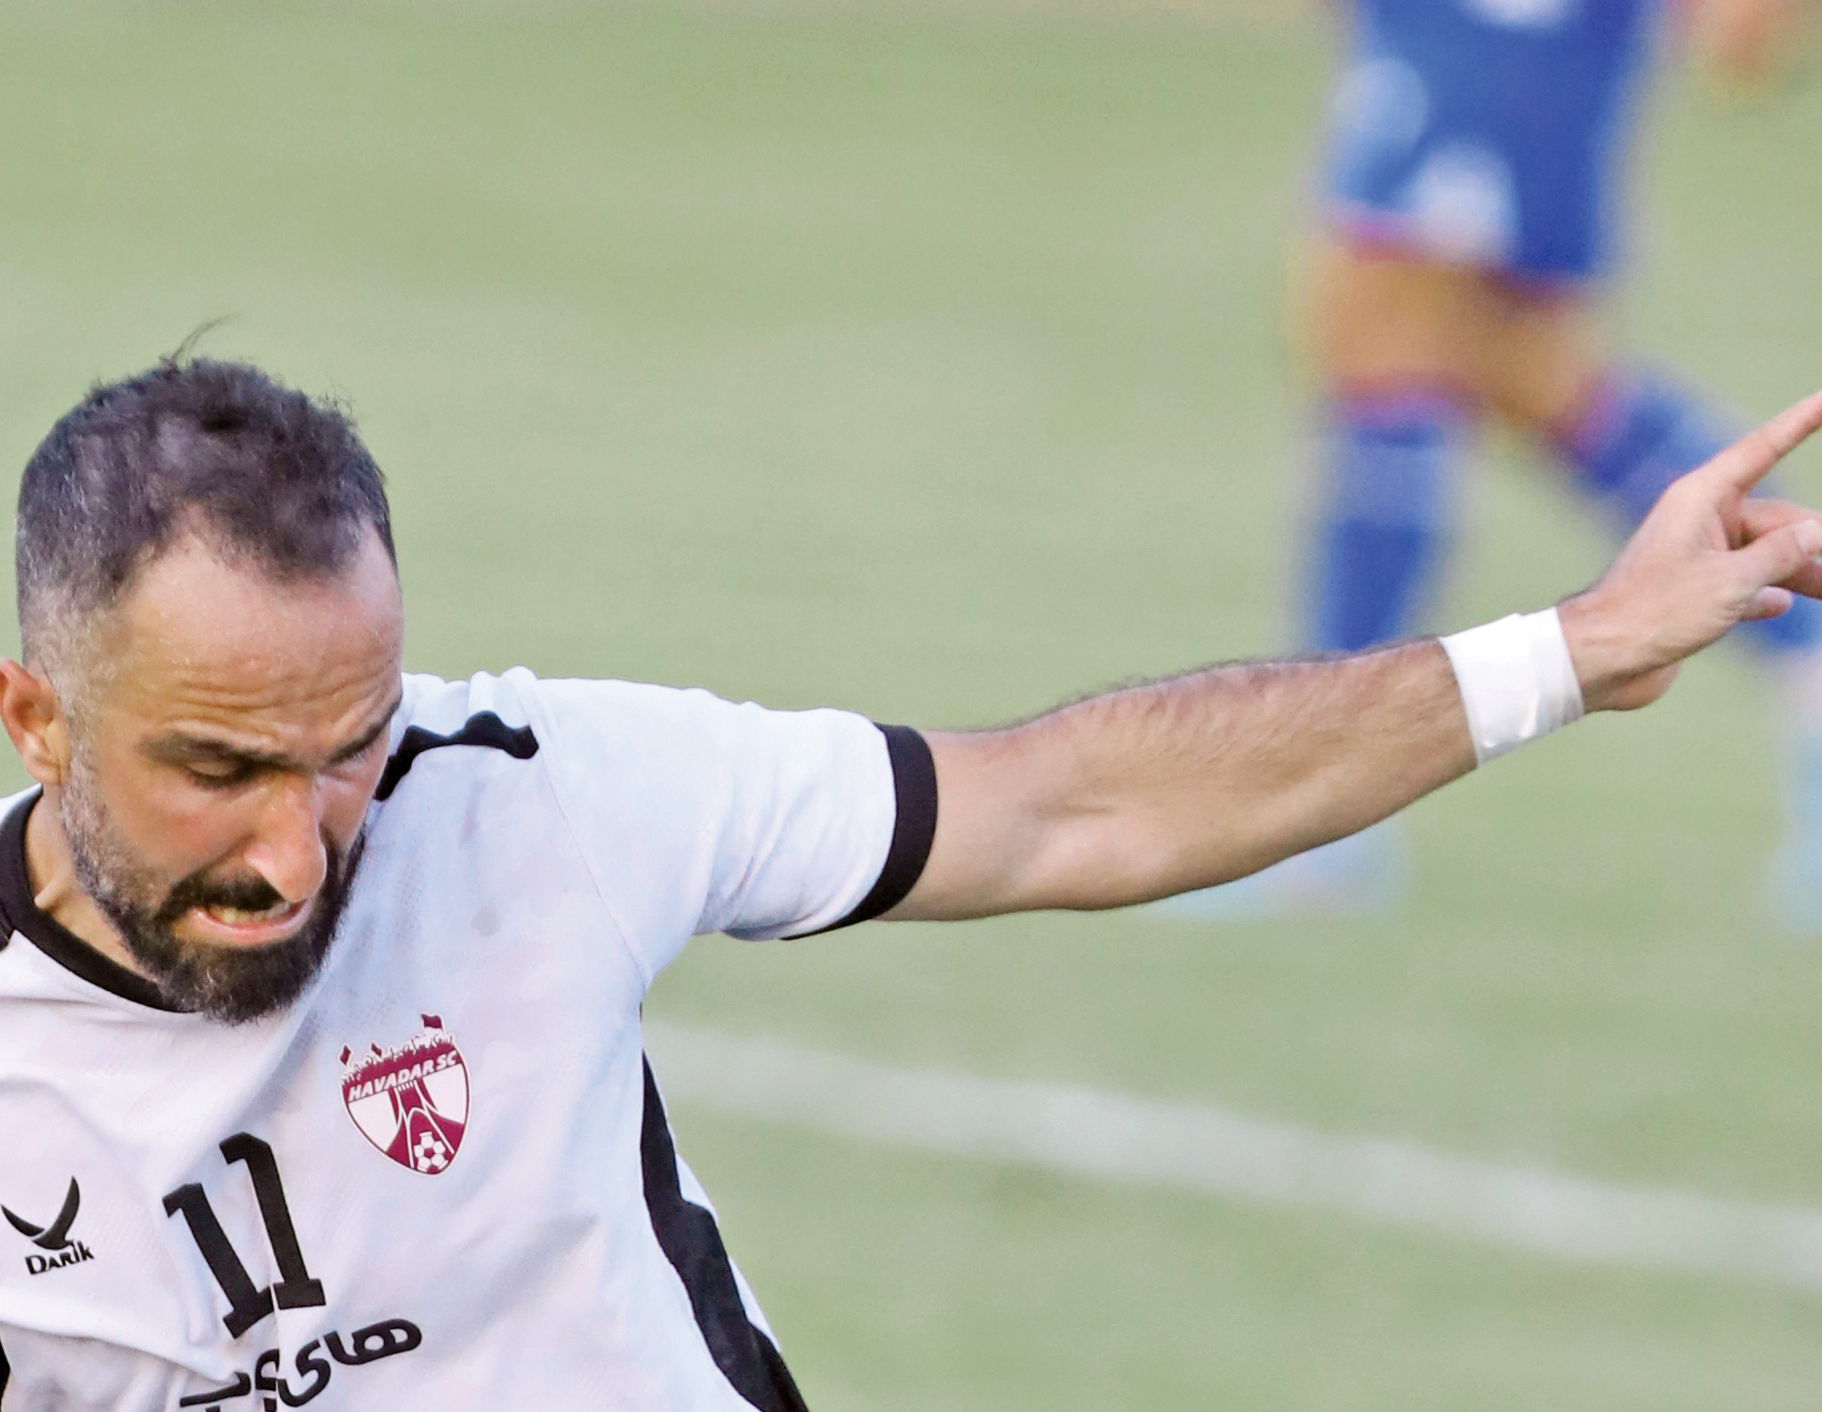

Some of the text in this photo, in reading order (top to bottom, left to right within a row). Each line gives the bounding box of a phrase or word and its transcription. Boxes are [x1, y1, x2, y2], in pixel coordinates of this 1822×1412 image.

[347, 1051, 457, 1101] HAVADAR SC
[162, 1131, 326, 1339] 11
